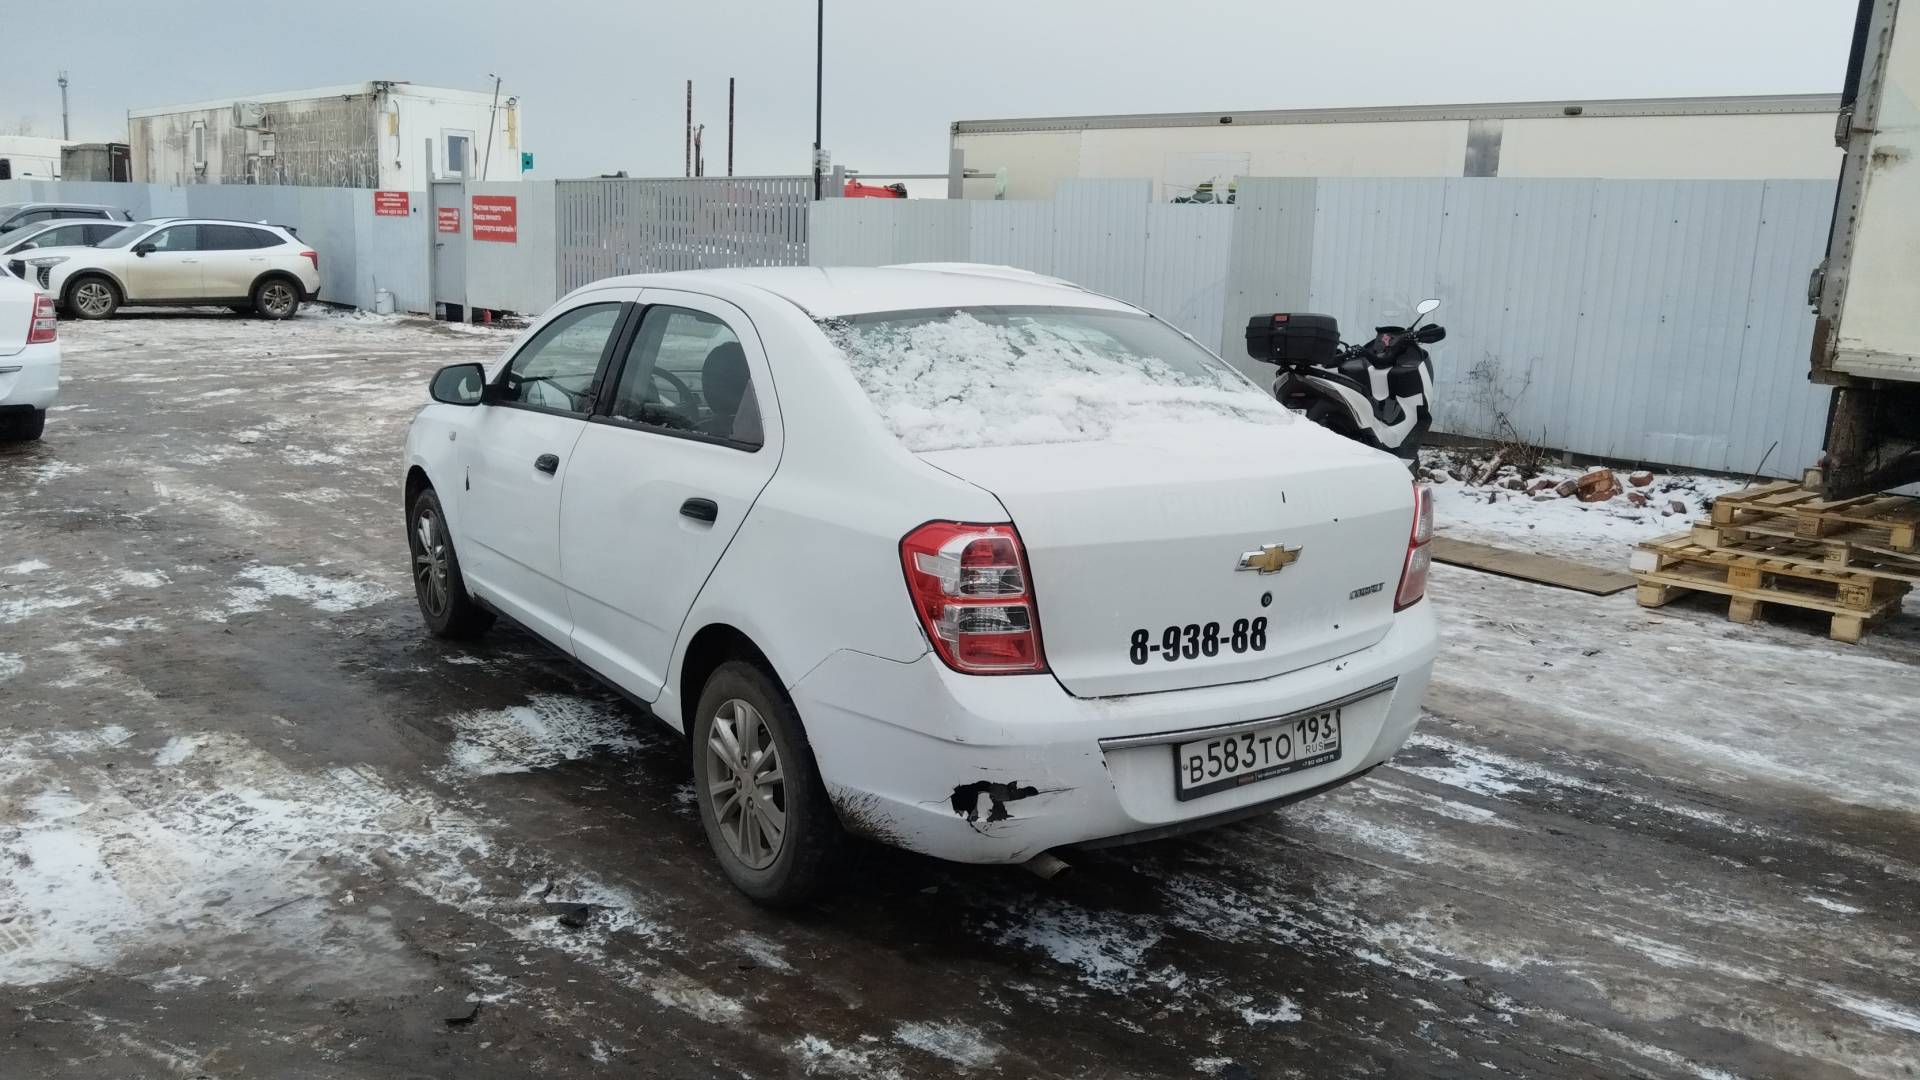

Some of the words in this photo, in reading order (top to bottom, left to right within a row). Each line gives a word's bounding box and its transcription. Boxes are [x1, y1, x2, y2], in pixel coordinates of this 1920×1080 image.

[1129, 616, 1268, 666] 8-938-88
[1296, 713, 1332, 745] 193
[1305, 740, 1325, 755] RUS
